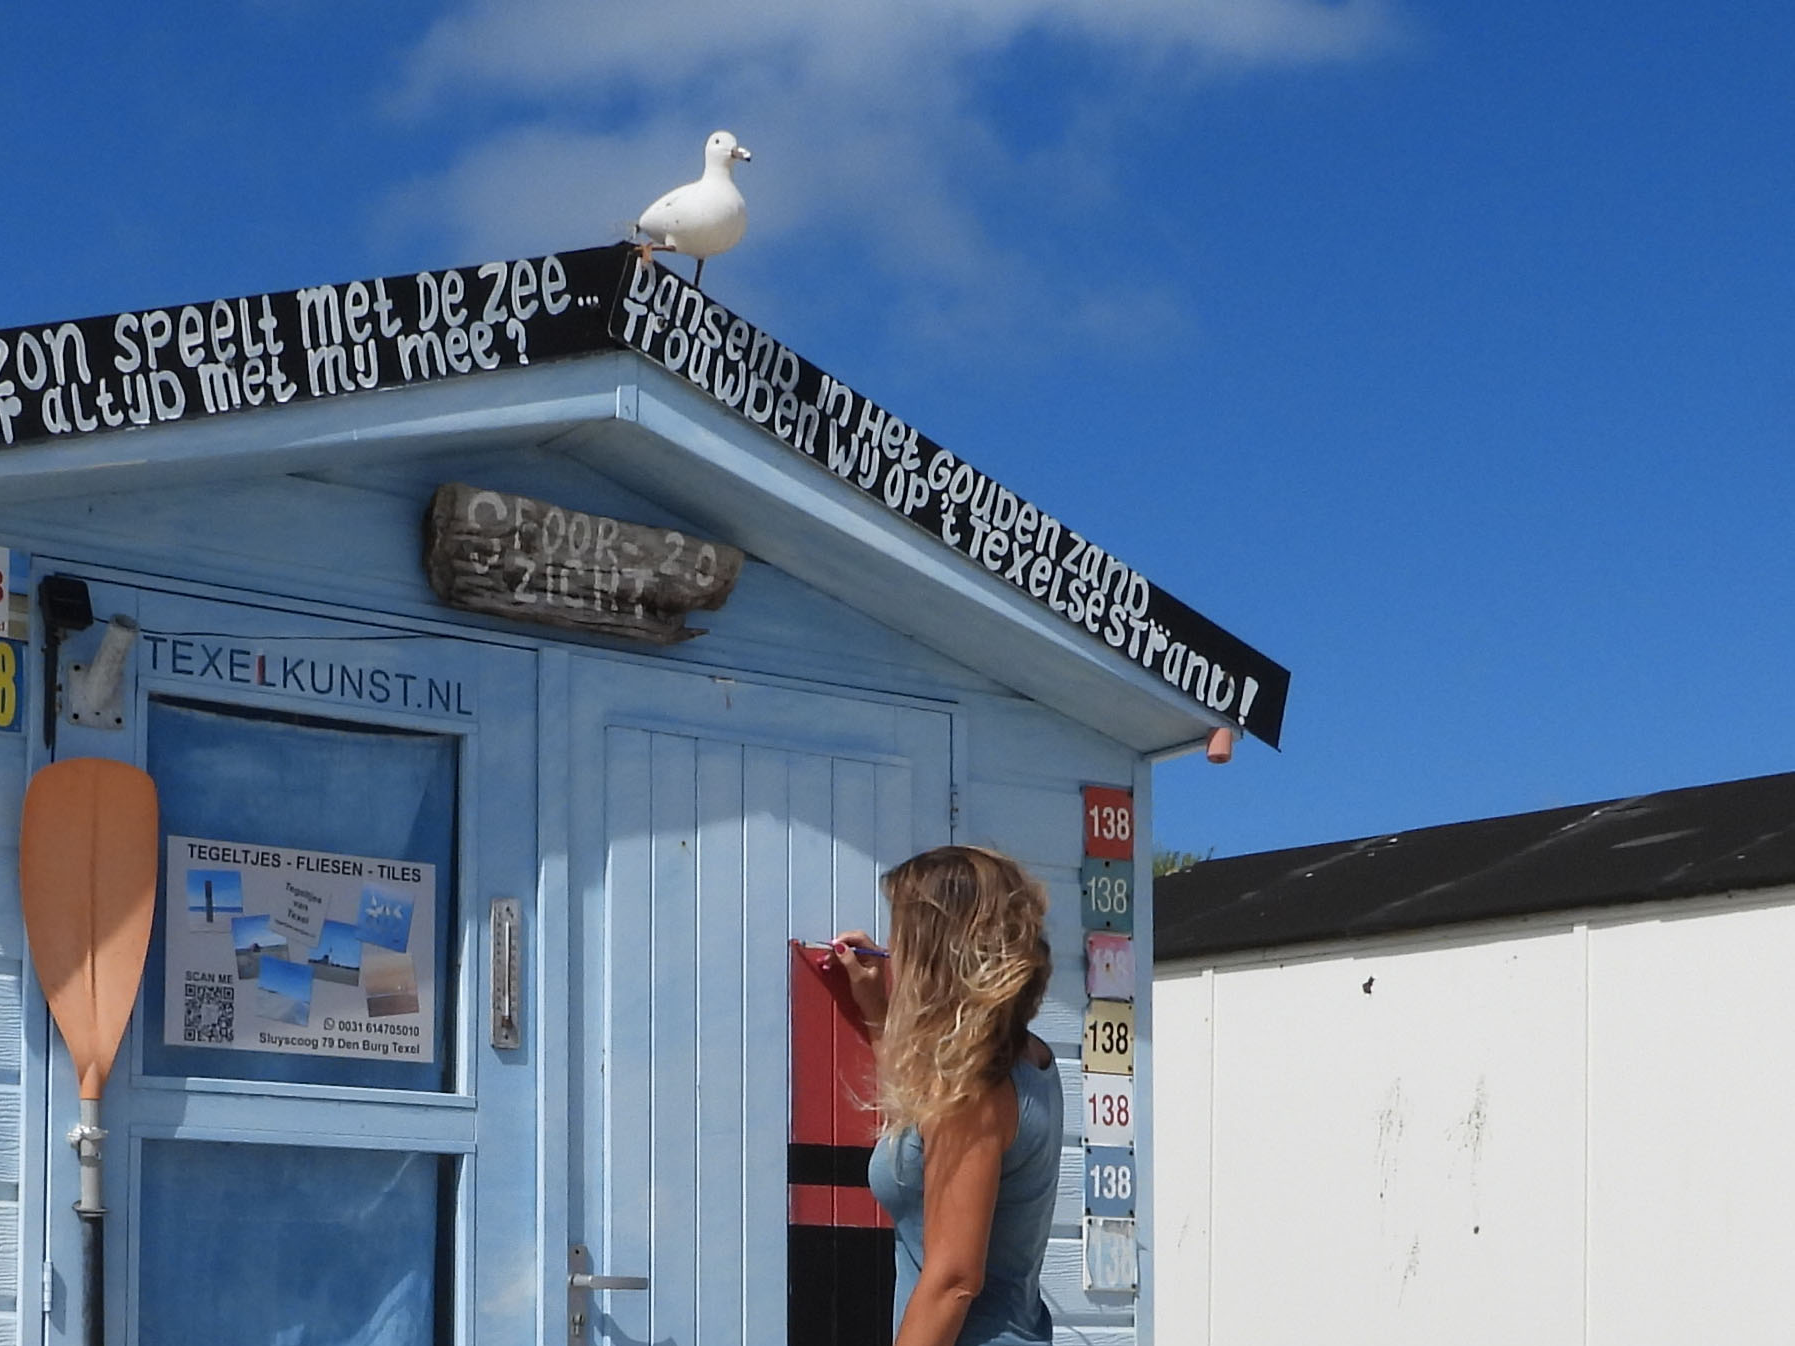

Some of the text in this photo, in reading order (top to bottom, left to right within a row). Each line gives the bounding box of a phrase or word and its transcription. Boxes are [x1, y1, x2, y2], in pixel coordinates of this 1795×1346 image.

[297, 277, 401, 349] met
[197, 357, 297, 414] met
[143, 634, 473, 716] TEXELKUNST.NL
[1089, 805, 1130, 840] 138
[188, 843, 281, 868] TEGELTJES
[296, 856, 362, 877] FLIESEN
[378, 865, 421, 883] TILES
[1087, 876, 1127, 914] 138
[186, 970, 233, 984] SCAN ME
[362, 1040, 389, 1055] Burg
[1088, 1020, 1129, 1054] 138
[1088, 1093, 1130, 1126] 138
[1090, 1164, 1132, 1200] 138
